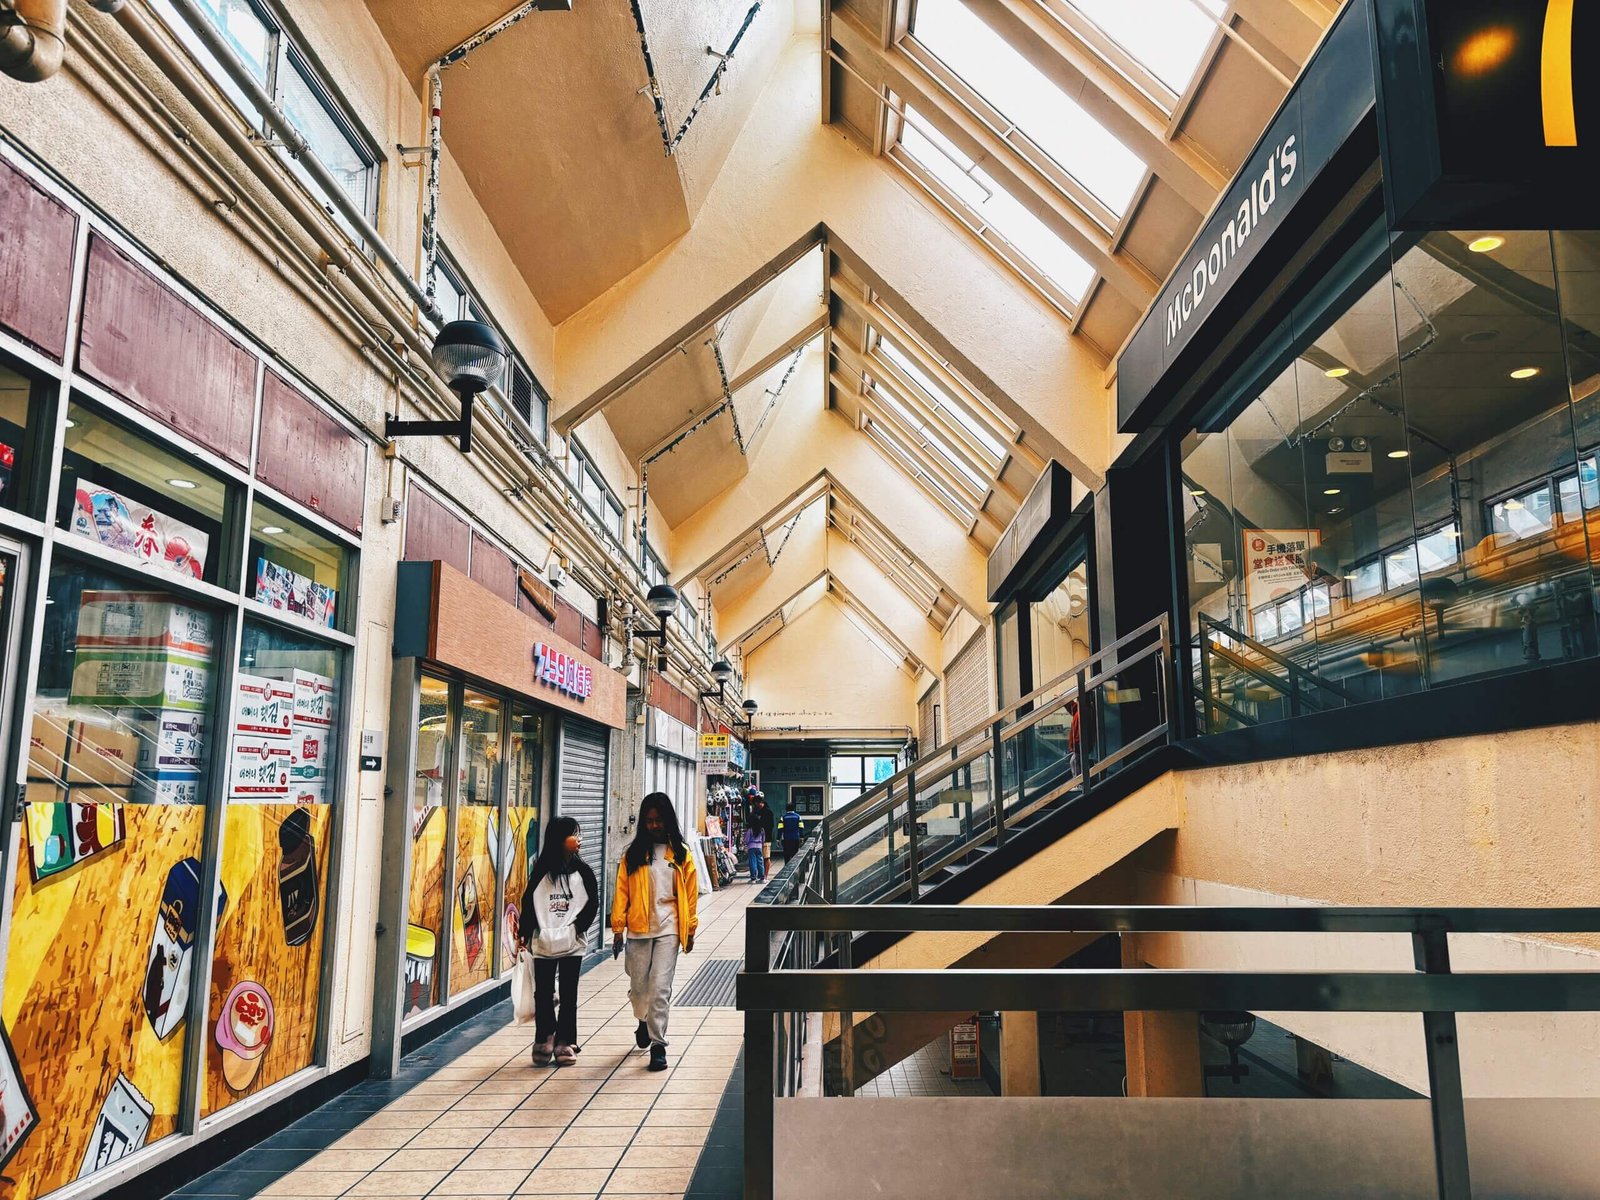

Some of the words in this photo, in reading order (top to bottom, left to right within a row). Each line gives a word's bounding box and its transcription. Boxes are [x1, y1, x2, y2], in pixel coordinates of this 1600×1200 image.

[1165, 133, 1299, 347] McDonald's
[133, 512, 160, 558] 春
[1267, 540, 1306, 555] 手機落單
[536, 642, 592, 698] 759阿信屋
